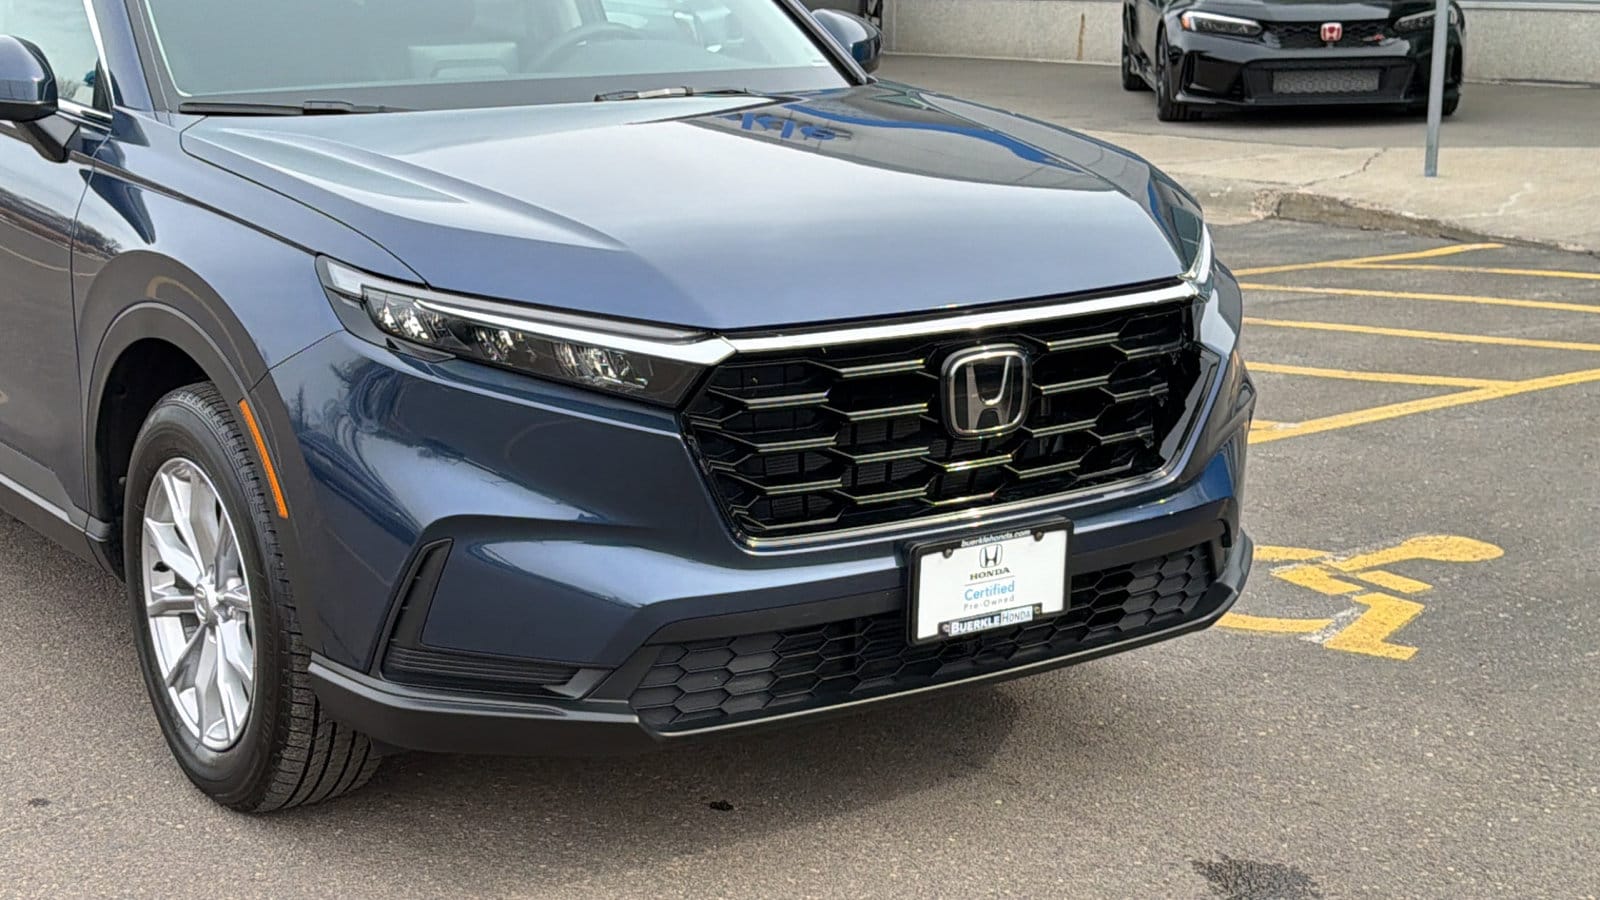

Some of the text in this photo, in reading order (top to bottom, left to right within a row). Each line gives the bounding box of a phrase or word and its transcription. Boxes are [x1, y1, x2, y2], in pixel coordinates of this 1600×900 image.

[961, 530, 1031, 547] buerklehonda.com
[970, 567, 1010, 580] HONDA
[964, 580, 1015, 601] Certified
[964, 594, 1015, 610] Pre-Owned
[951, 610, 1031, 633] BUERKLE HONDA
